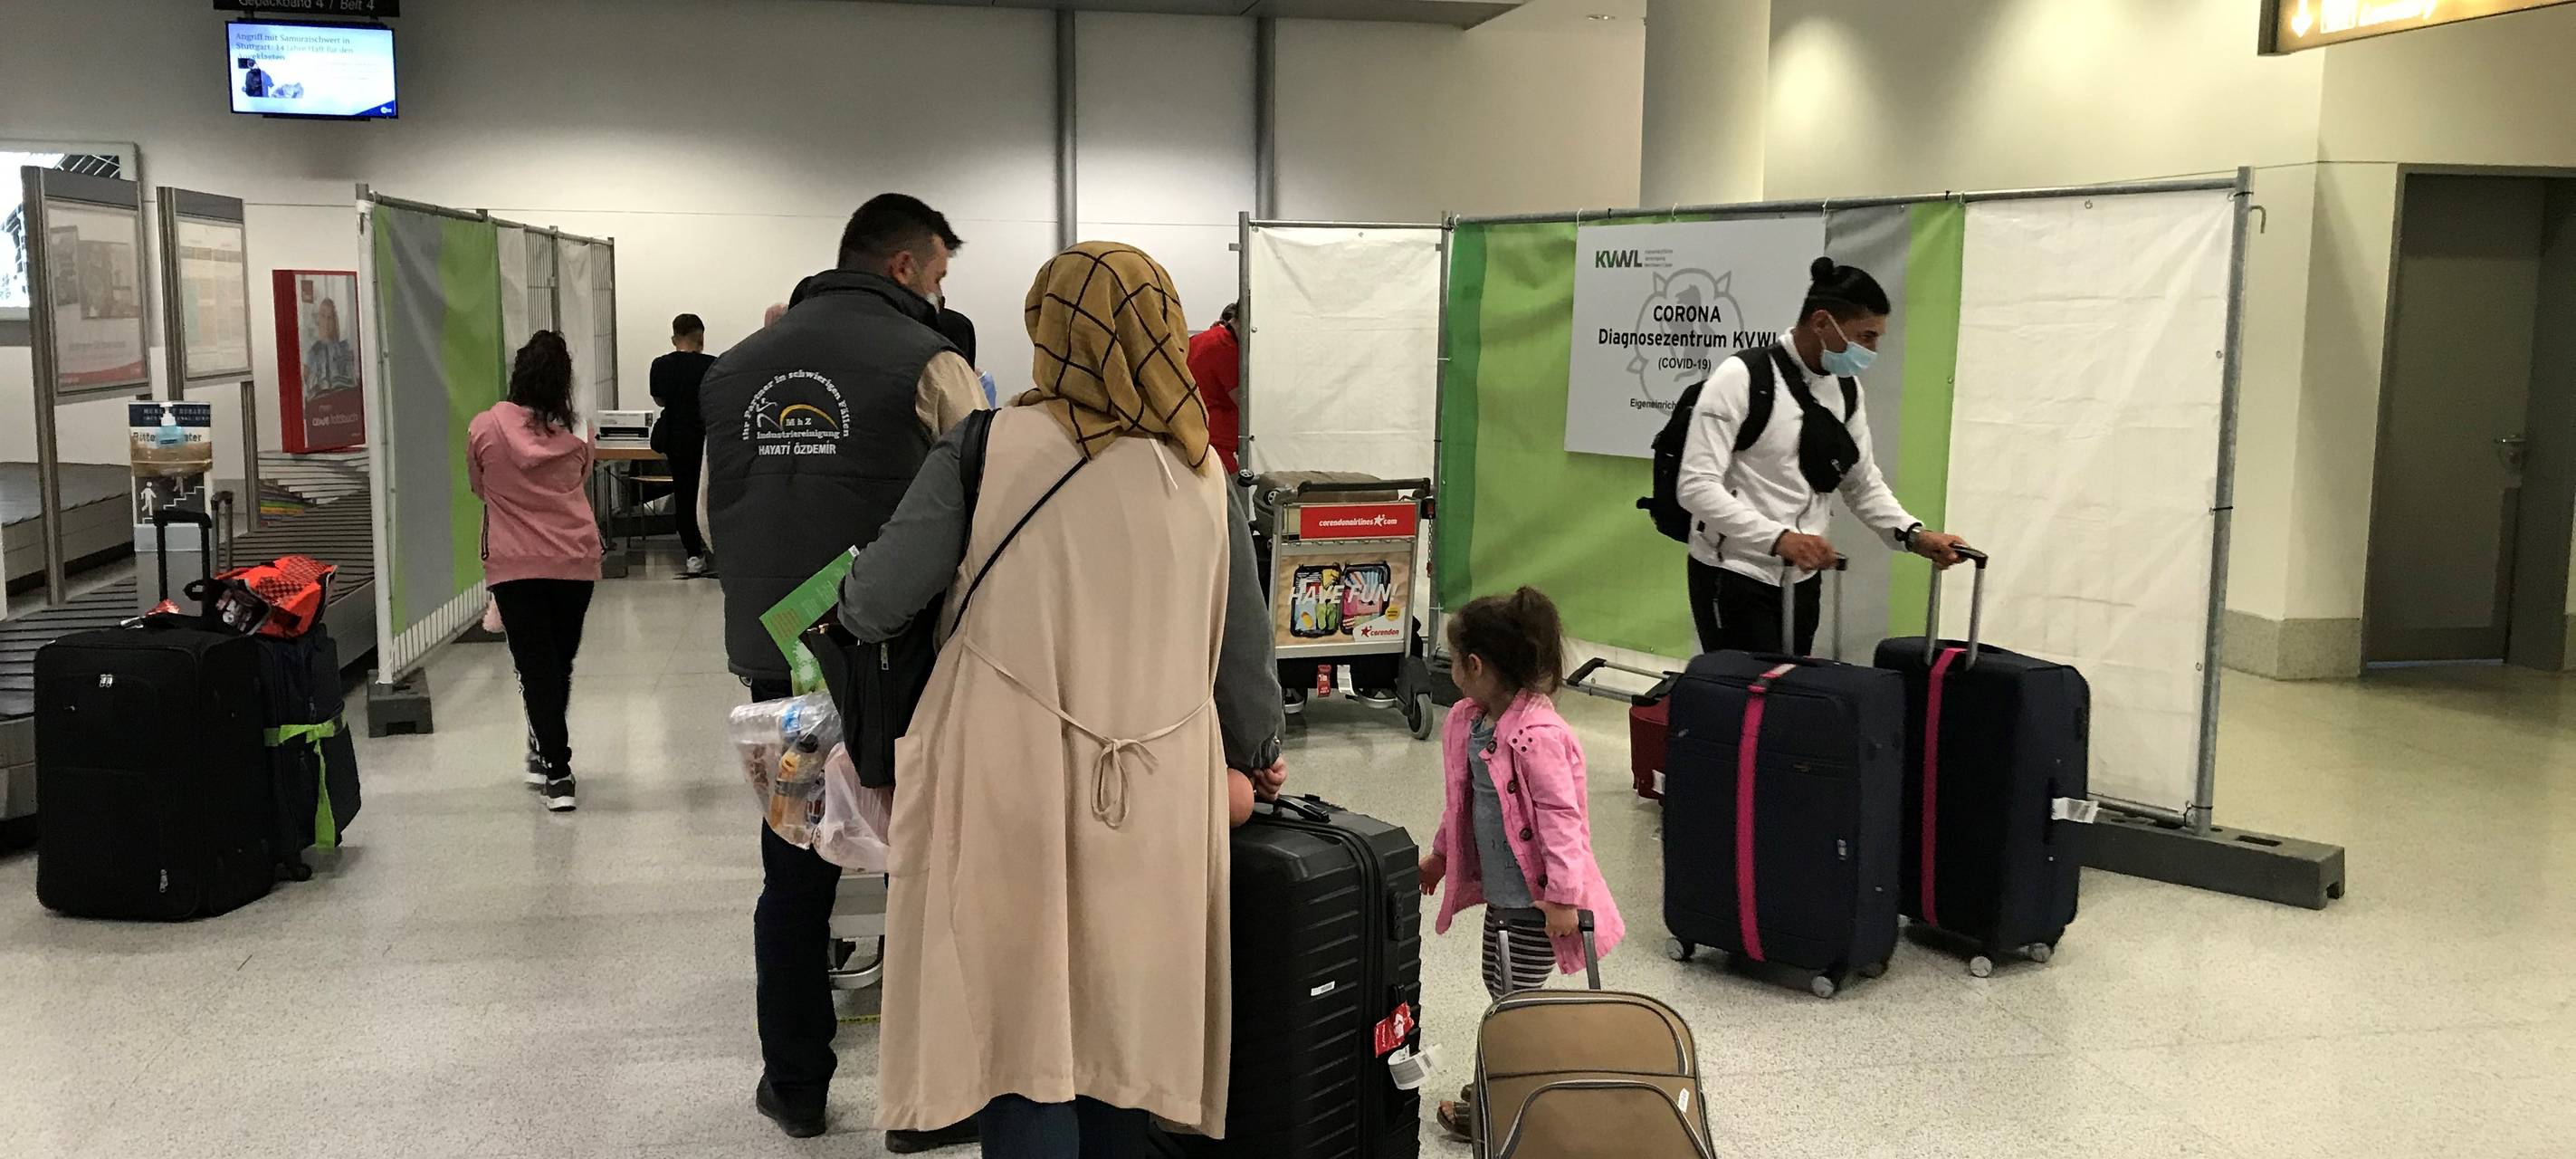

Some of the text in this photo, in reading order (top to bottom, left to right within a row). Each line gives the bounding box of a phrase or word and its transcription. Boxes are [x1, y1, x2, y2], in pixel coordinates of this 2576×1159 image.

[366, 0, 375, 10] 4
[280, 34, 341, 44] Samuraischwert
[1595, 249, 1643, 269] KVWL
[1653, 305, 1722, 322] CORONA
[1598, 328, 1727, 349] Diagnosezentrum
[1658, 357, 1712, 373] (COVID-19)
[774, 375, 787, 384] in
[788, 369, 841, 400] schwierigen
[1630, 398, 1677, 410] Eigeneinrich
[1369, 627, 1400, 637] corendon
